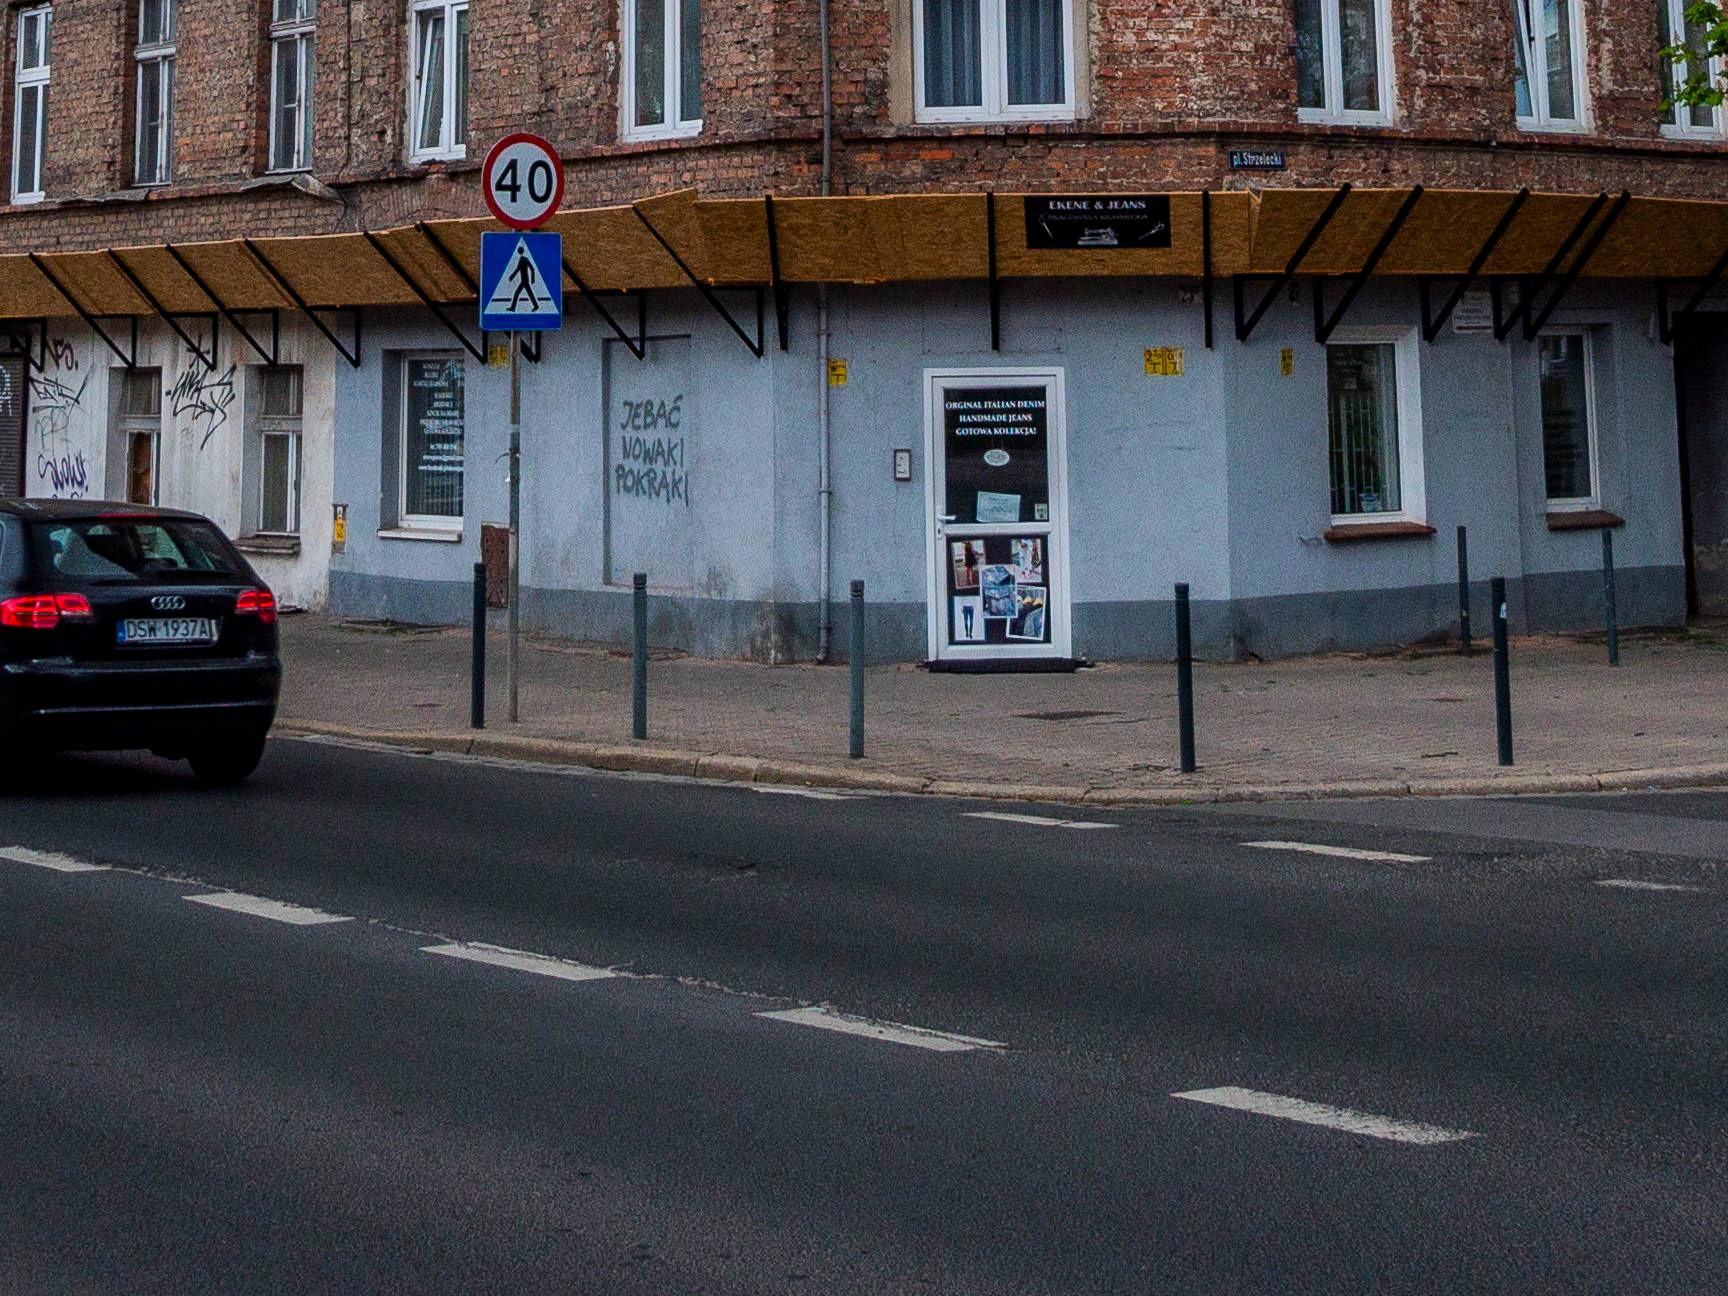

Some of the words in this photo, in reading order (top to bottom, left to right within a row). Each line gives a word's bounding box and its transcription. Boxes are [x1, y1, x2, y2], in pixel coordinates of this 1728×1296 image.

[1242, 151, 1282, 165] Strzelecki
[494, 158, 554, 204] 40
[1049, 200, 1090, 210] EKENE
[1094, 200, 1104, 210] &
[1107, 200, 1147, 210] JEANS
[620, 393, 684, 430] JEBAĆ
[945, 400, 982, 410] ORGINAL
[984, 400, 1016, 409] ITALIAN
[1017, 399, 1045, 408] DENIM
[959, 414, 1007, 423] HANDMADE
[1008, 413, 1033, 423] JEANS
[955, 427, 992, 436] GOTOWA
[993, 427, 1037, 436] KOLEKCJA!
[622, 435, 684, 468] NOWAKI
[615, 464, 689, 507] POKRAKI
[125, 619, 158, 639] DSW
[163, 619, 210, 638] 1937A
